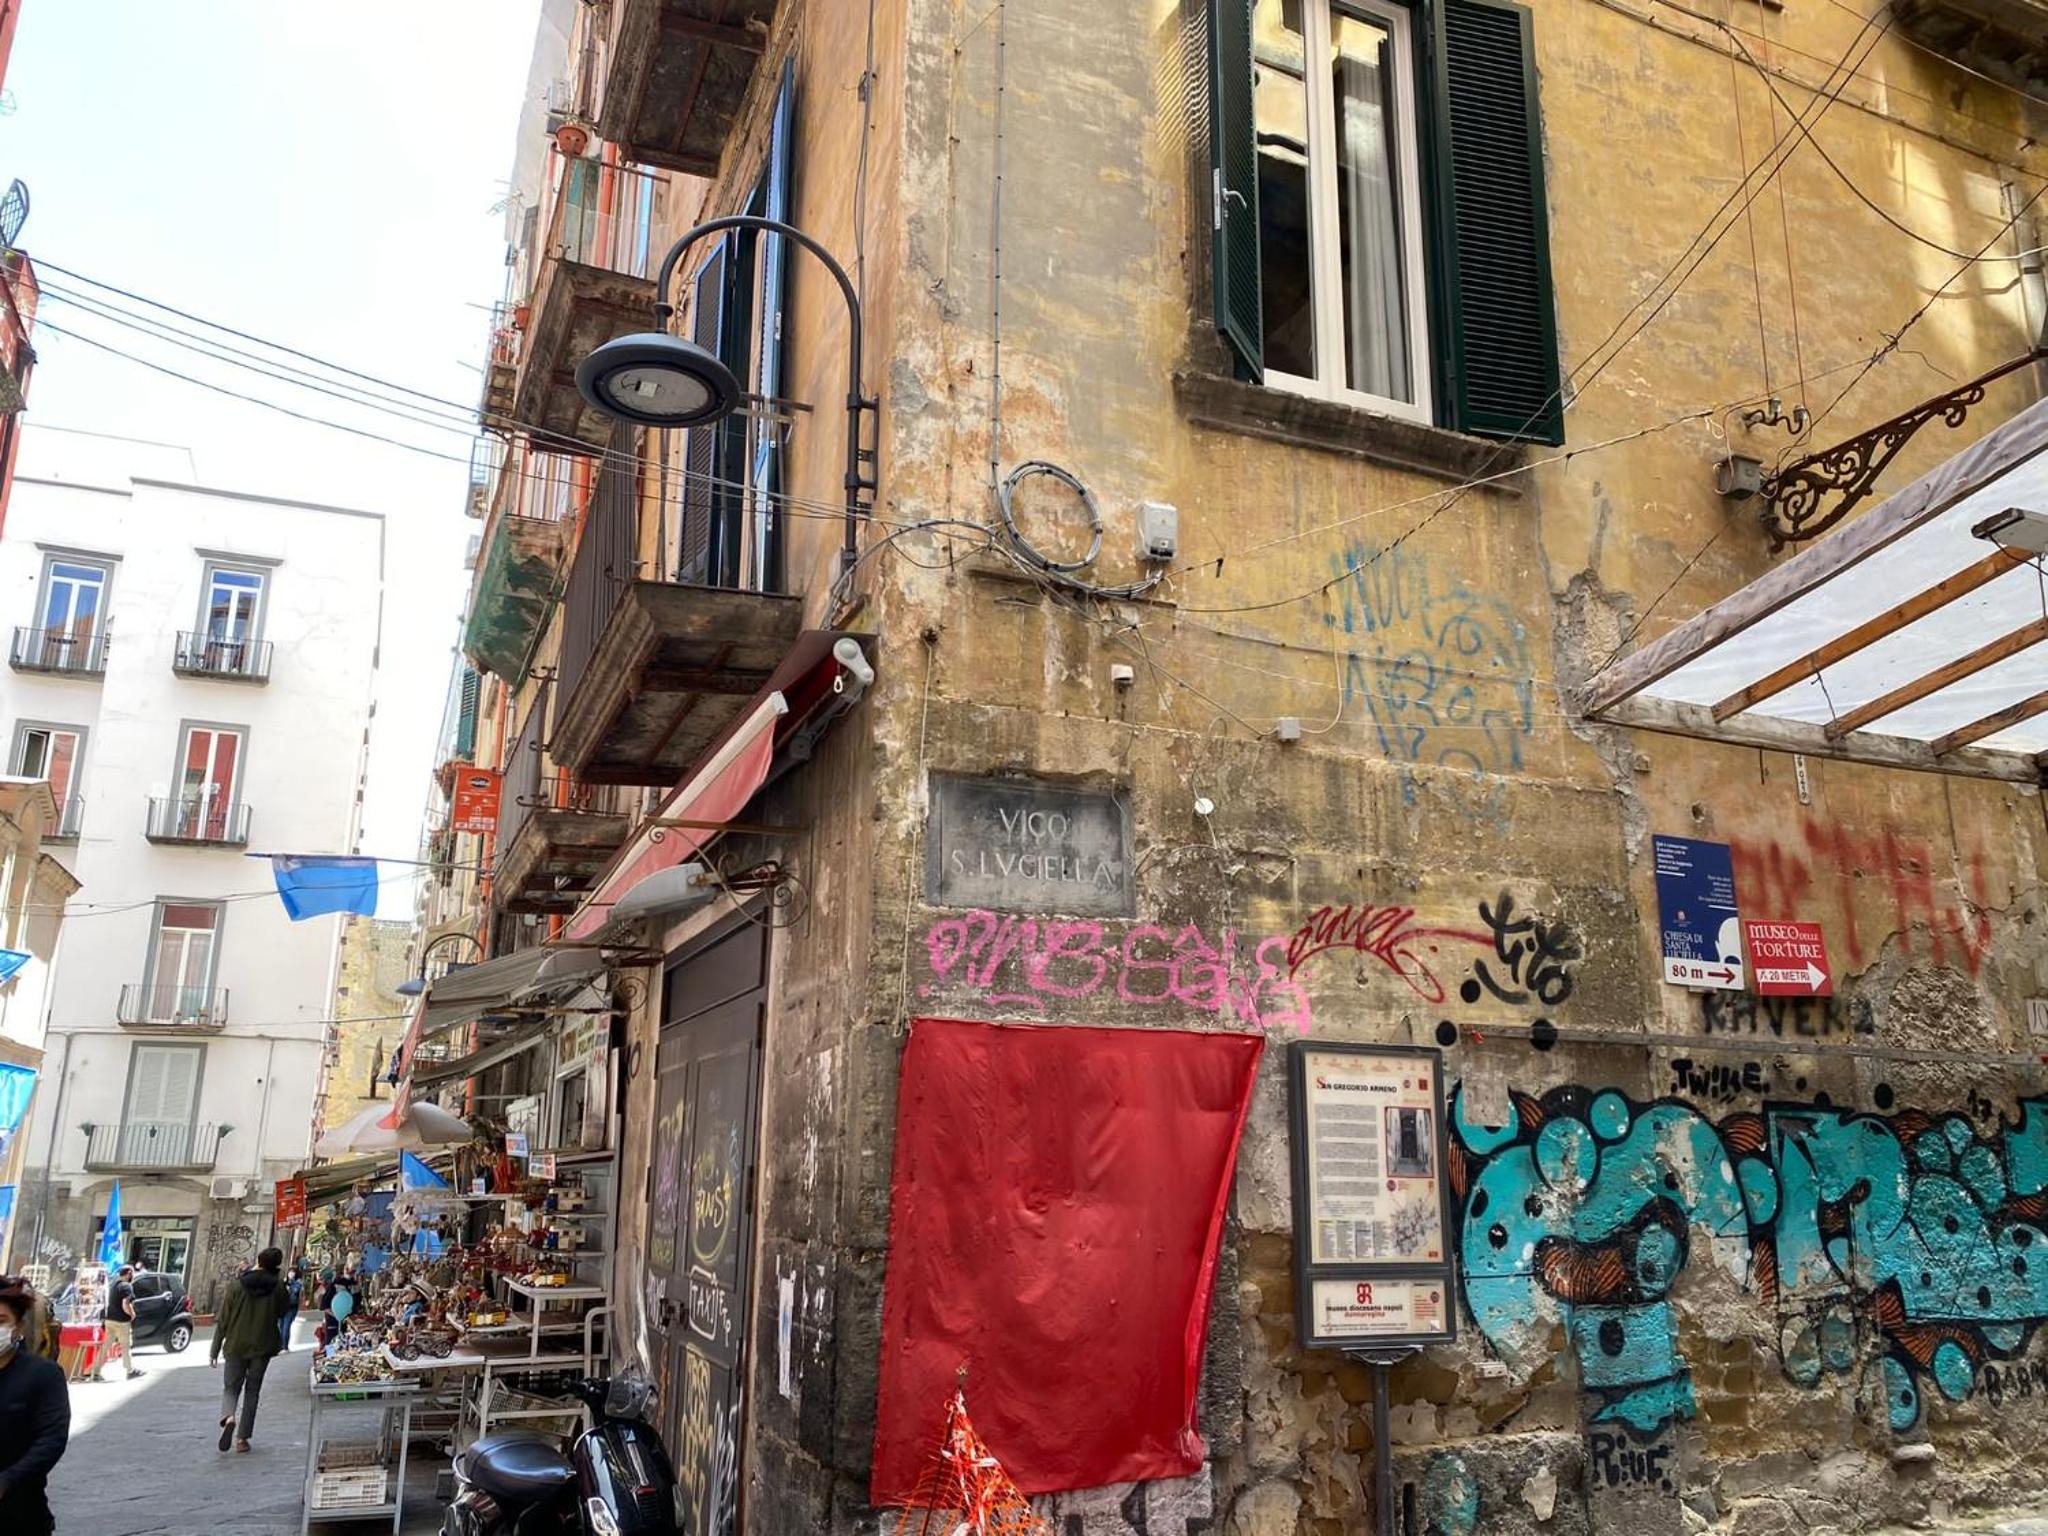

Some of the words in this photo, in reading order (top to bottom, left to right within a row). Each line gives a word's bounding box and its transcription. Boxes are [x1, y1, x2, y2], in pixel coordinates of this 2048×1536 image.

[998, 808, 1067, 843] VICO
[1664, 930, 1693, 943] CHIESA
[1693, 934, 1704, 944] DI
[1749, 924, 1799, 940] MUSEO
[1799, 933, 1818, 941] DELLE
[1665, 940, 1692, 951] SANTA
[1752, 940, 1823, 959] TORTURE
[1672, 965, 1687, 978] 80
[1691, 968, 1704, 979] m
[1333, 1083, 1368, 1092] GREGORIO
[1369, 1084, 1398, 1093] ARMENO
